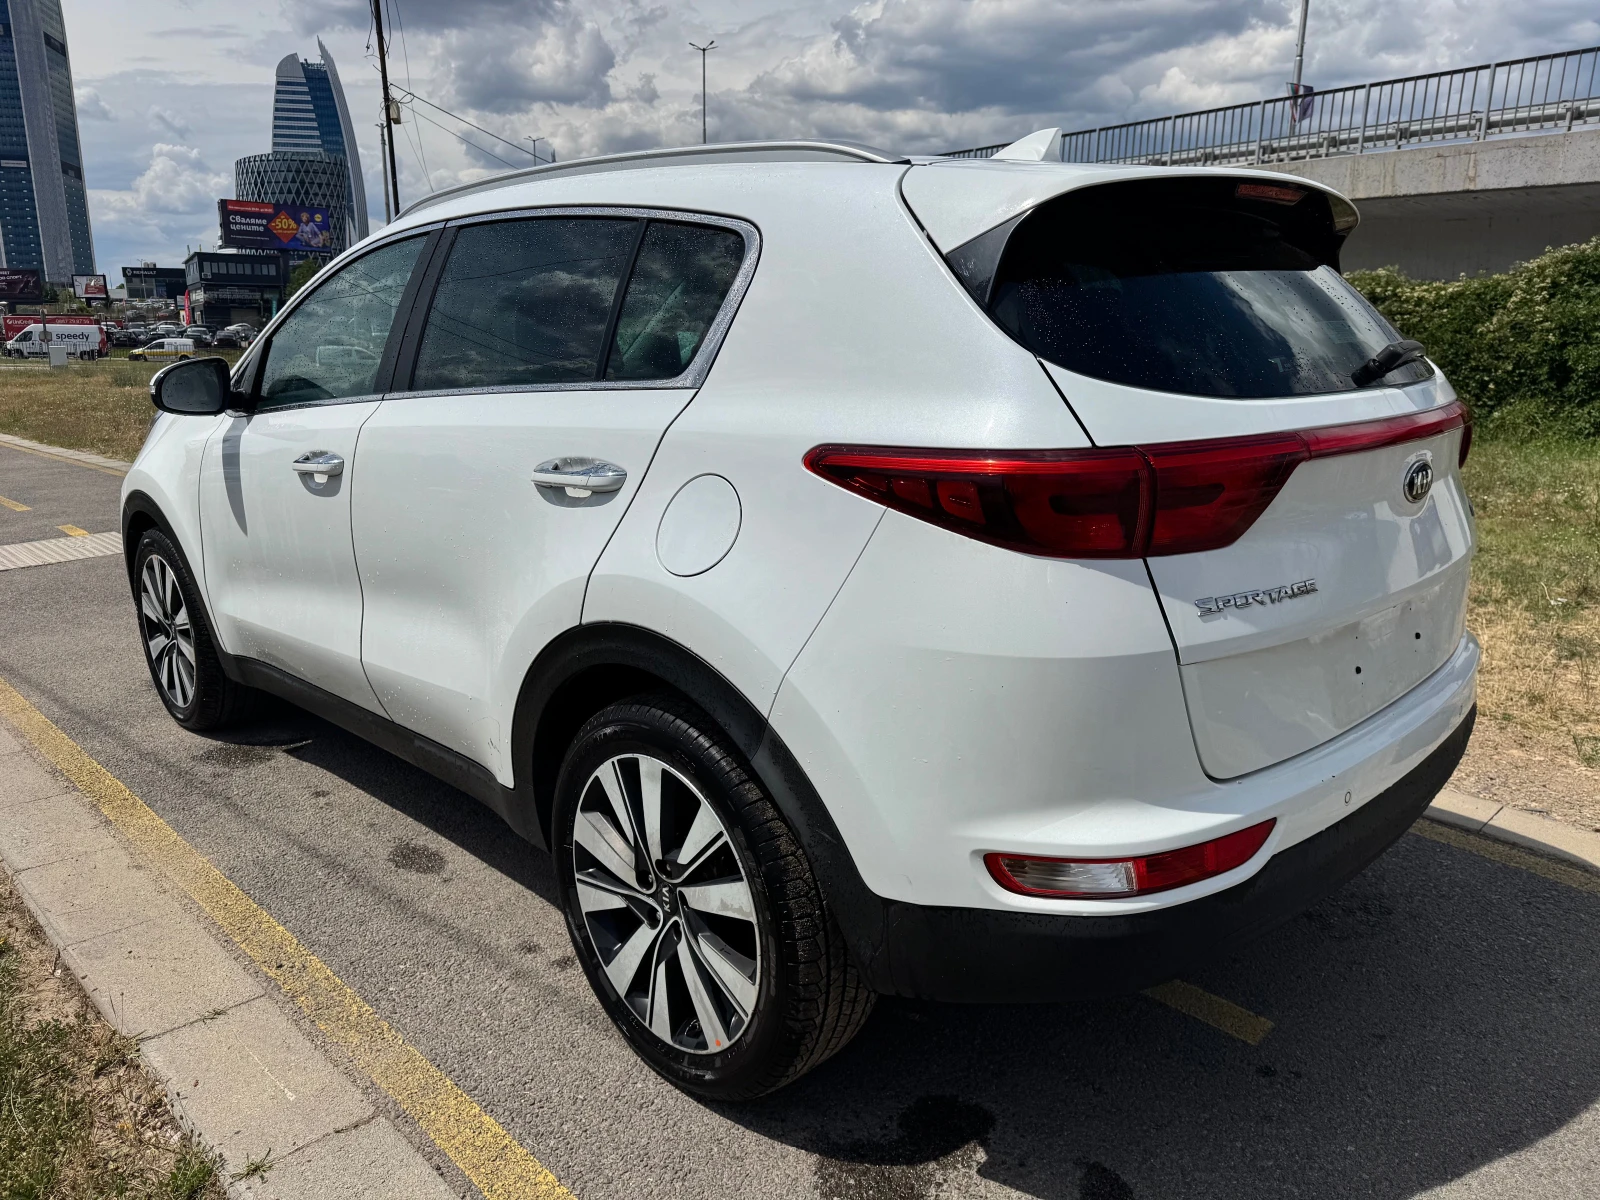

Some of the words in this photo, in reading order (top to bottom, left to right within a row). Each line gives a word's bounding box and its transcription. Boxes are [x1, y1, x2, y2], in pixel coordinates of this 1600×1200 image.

[229, 214, 267, 225] Сваляме
[271, 218, 297, 229] -50%
[230, 223, 264, 232] цените
[55, 331, 90, 341] speedy
[1194, 578, 1318, 617] SPORTAGE
[662, 886, 671, 912] KIA
